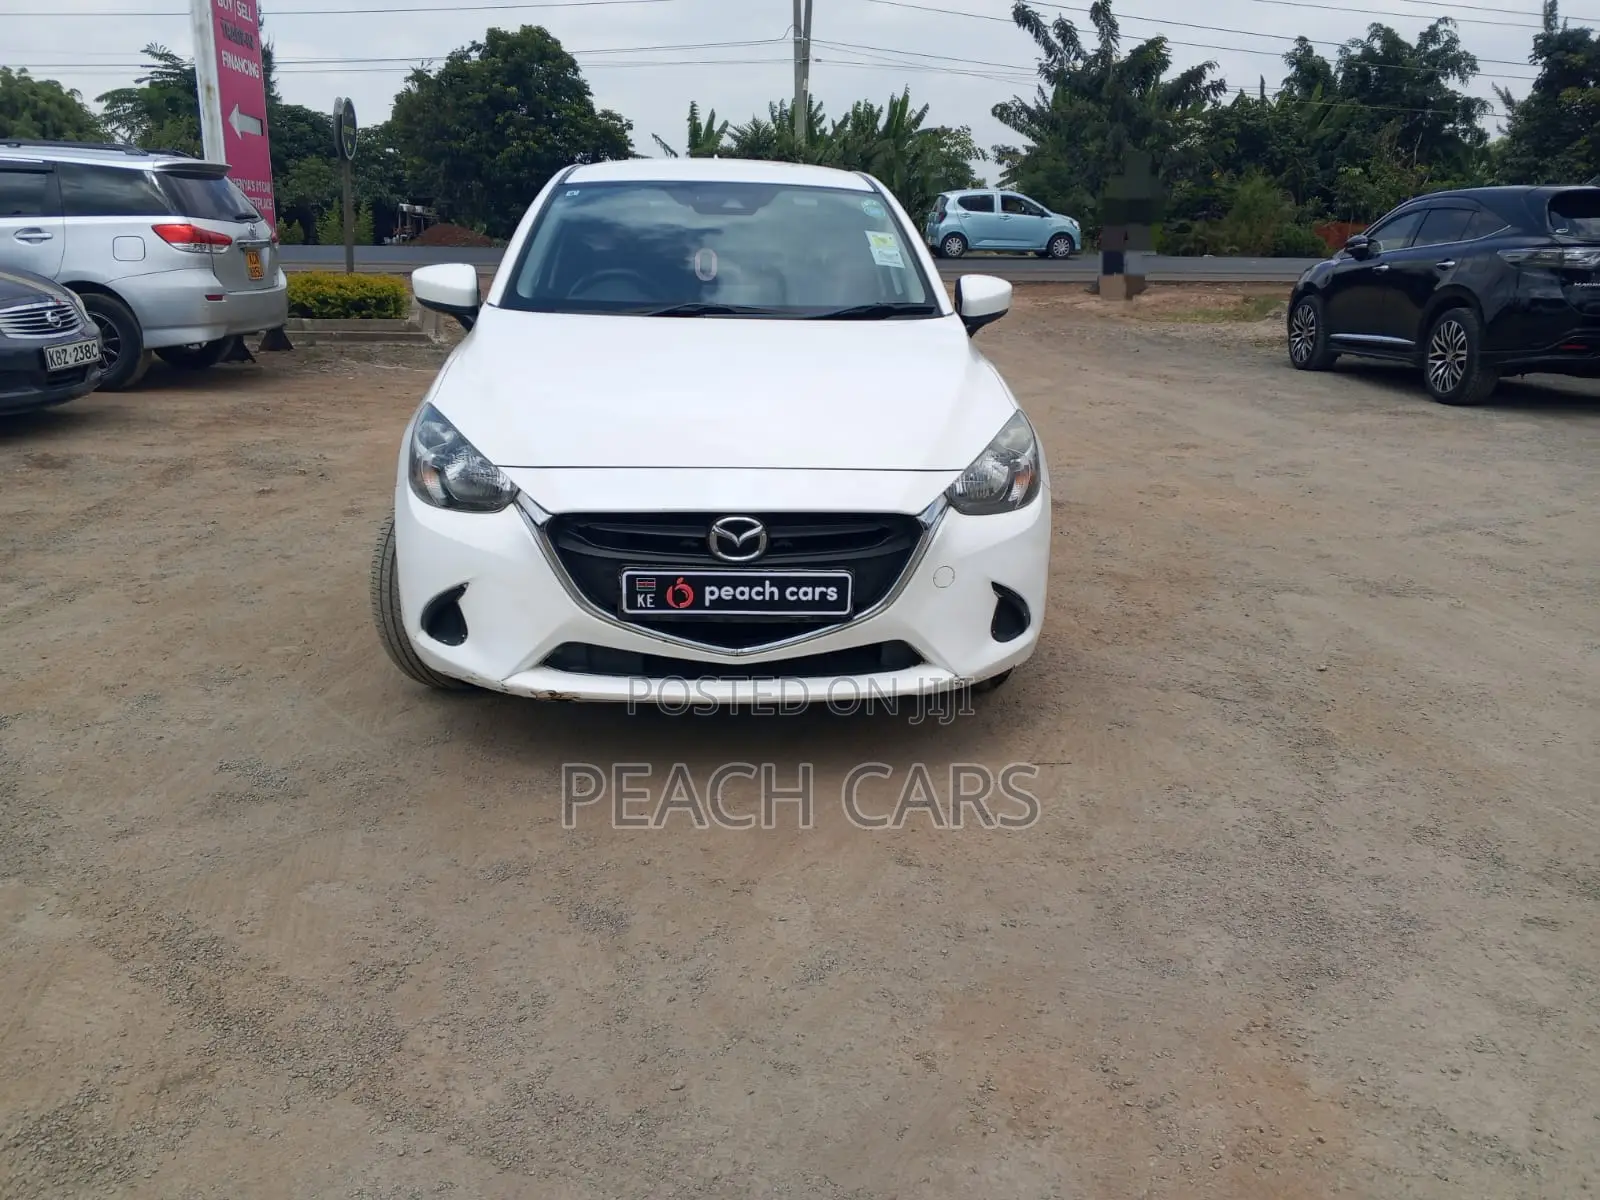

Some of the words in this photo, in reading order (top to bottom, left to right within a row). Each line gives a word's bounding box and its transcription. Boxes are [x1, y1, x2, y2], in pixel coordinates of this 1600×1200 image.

[236, 0, 253, 22] SELL
[221, 49, 259, 79] FINANCING
[48, 348, 69, 368] KBZ
[73, 343, 98, 362] 238C
[637, 594, 655, 607] KE
[705, 580, 779, 607] peach
[785, 586, 838, 601] cars
